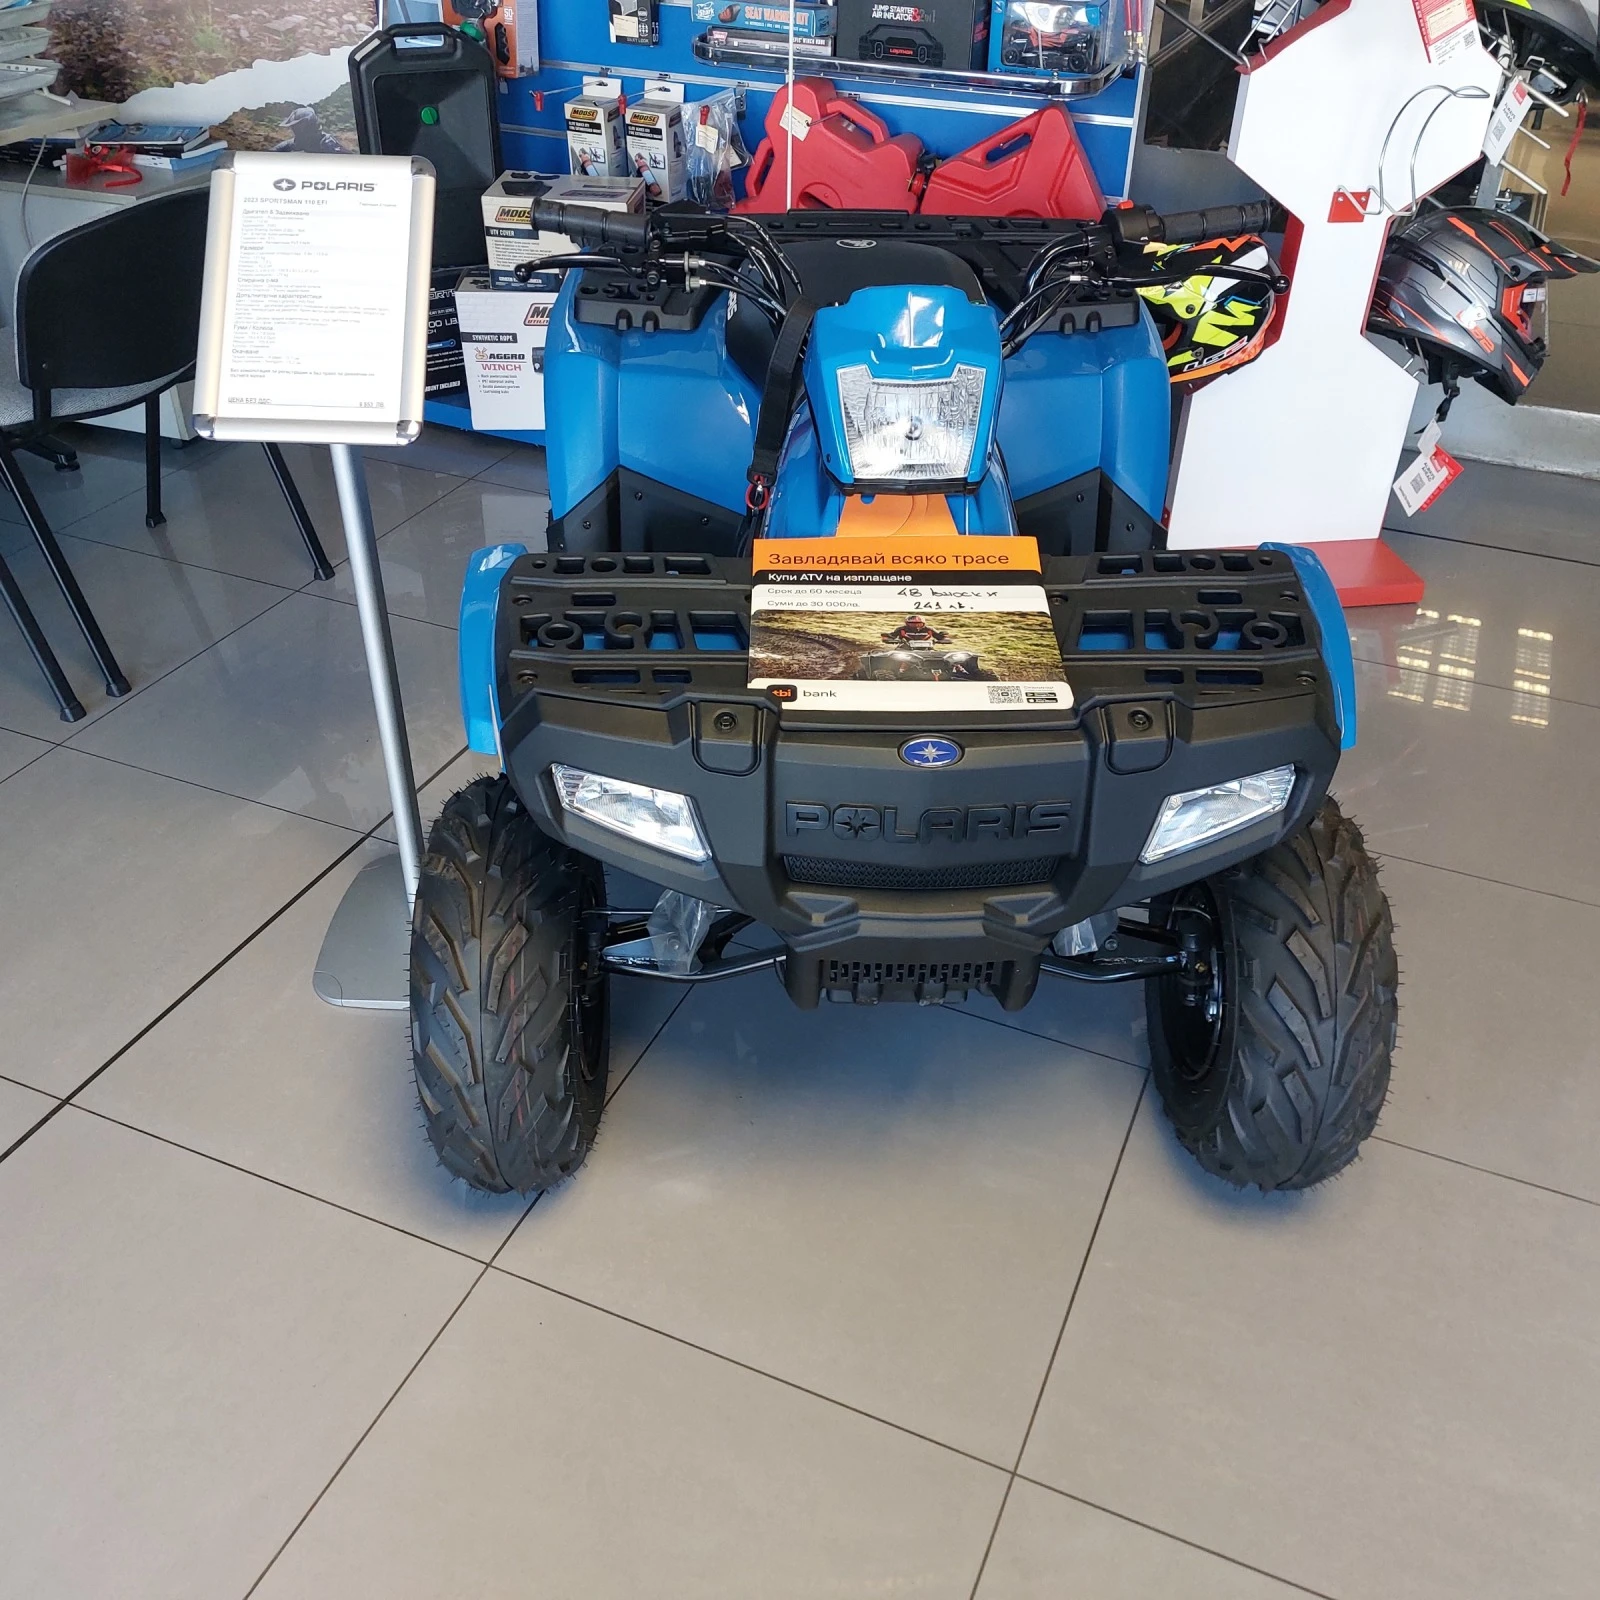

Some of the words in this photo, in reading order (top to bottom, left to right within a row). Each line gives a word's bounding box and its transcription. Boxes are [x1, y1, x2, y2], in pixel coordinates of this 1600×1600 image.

[745, 6, 763, 19] SEAT
[872, 4, 889, 12] JUMP
[890, 6, 914, 14] STARTER
[872, 11, 883, 19] AIR
[883, 12, 913, 22] INFLATOR
[573, 108, 597, 117] MOOSE
[633, 114, 656, 122] MOOSE
[301, 180, 375, 192] POLARIS
[260, 197, 303, 205] SPORTSMAN
[499, 207, 532, 219] MOOS
[499, 334, 514, 342] ROPE
[768, 552, 885, 566] Завладявай
[891, 555, 947, 565] всяко
[952, 555, 1009, 567] трасе
[768, 573, 797, 582] Купи
[843, 575, 912, 583] изплащане
[897, 587, 923, 598] 48
[772, 689, 792, 697] tbi
[803, 689, 837, 697] bank
[785, 799, 1072, 844] POLARIS
